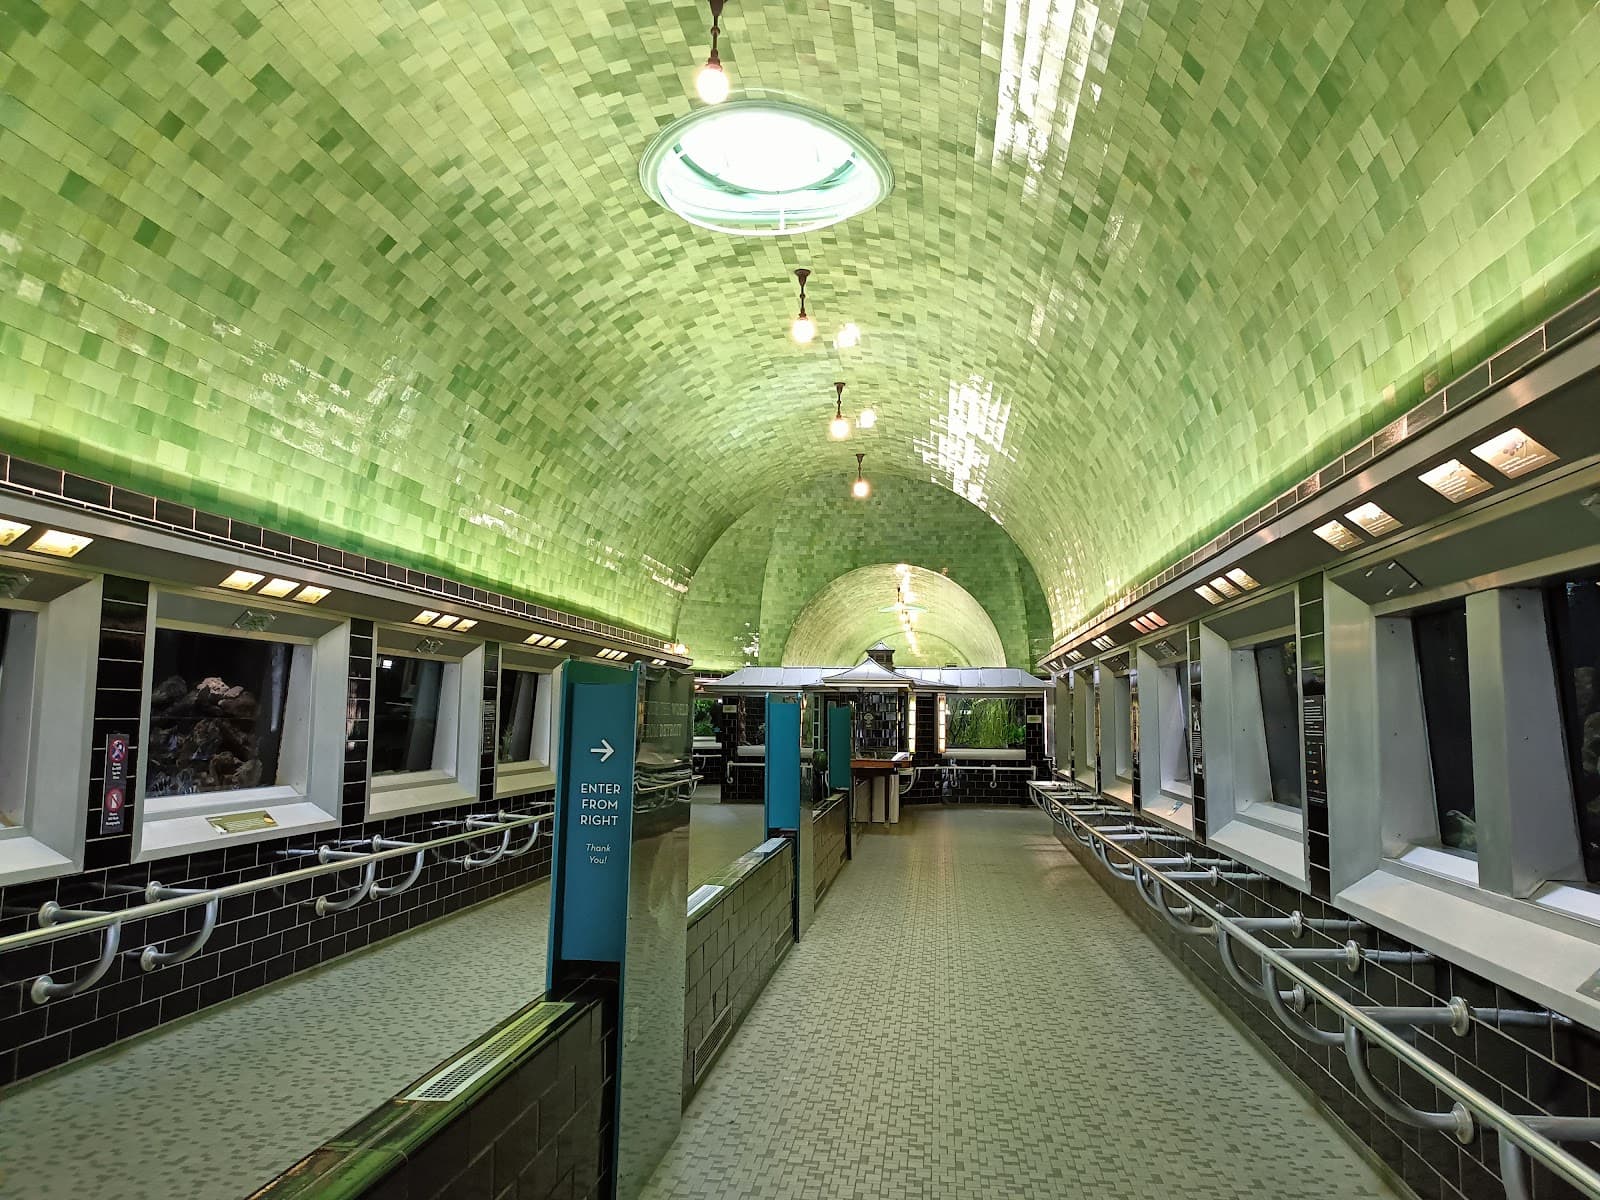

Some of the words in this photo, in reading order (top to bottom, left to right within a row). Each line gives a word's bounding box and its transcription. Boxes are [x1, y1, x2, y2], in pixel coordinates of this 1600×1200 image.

[580, 783, 621, 795] ENTER
[581, 798, 618, 811] FROM
[580, 814, 619, 826] RIGHT
[586, 843, 611, 853] Thank
[589, 856, 608, 864] You!
